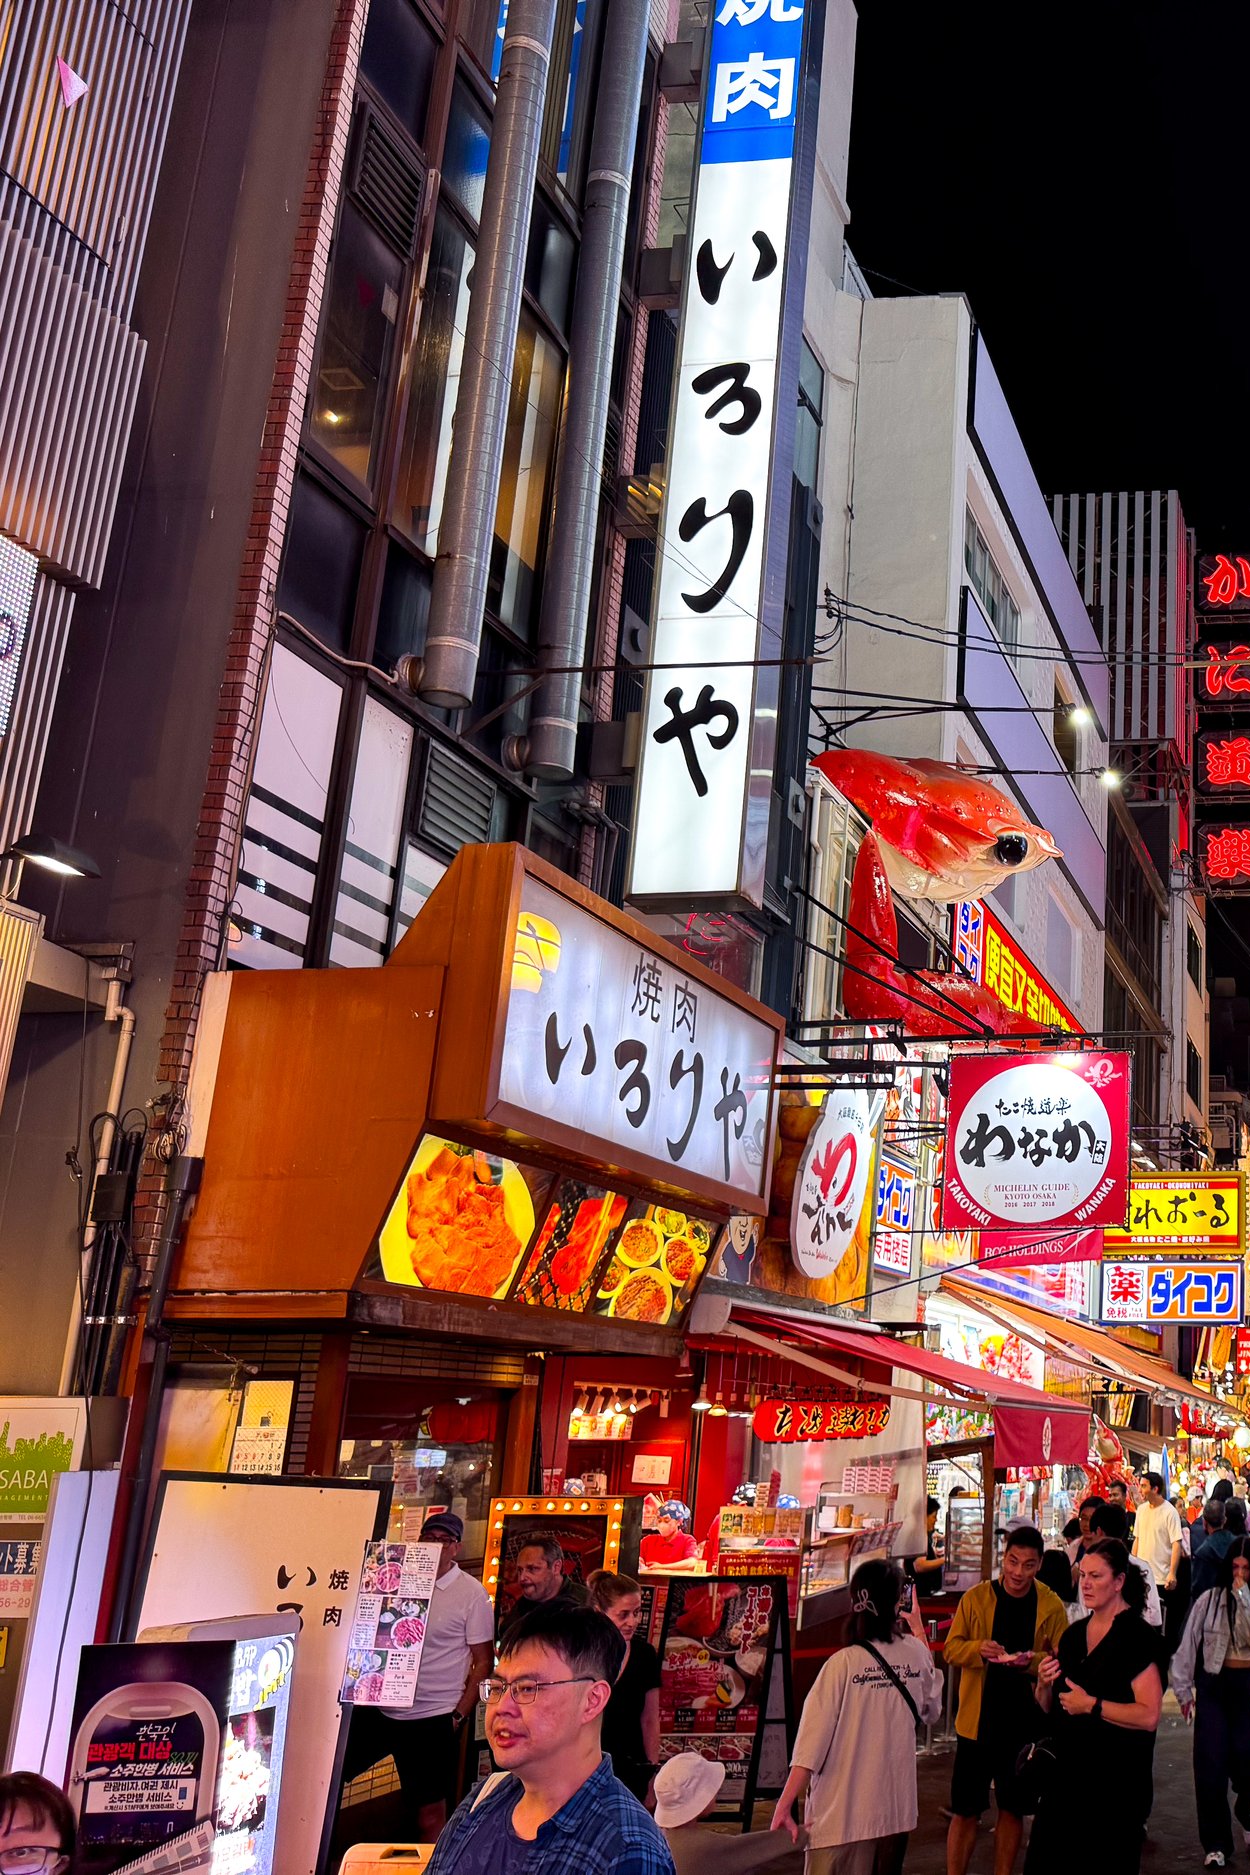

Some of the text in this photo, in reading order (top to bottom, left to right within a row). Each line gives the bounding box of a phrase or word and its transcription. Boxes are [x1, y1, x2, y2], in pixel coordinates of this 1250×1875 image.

[652, 231, 777, 798] いろりや
[631, 952, 698, 1043] 焼肉
[545, 1011, 750, 1181] いろりや
[960, 1113, 1096, 1168] わなか
[945, 1177, 992, 1226] TAKOYAKI
[993, 1183, 1070, 1192] MICHELIN GUIDE
[1074, 1177, 1117, 1223] WANAKA
[1130, 1192, 1230, 1230] れおーる
[1110, 1266, 1142, 1304] 薬
[1150, 1271, 1236, 1315] ダイコク
[1106, 1307, 1128, 1319] 免税
[322, 1569, 350, 1628] 焼肉
[87, 1741, 173, 1762] 관광객 대상
[136, 1722, 177, 1741] 한국인
[157, 1762, 194, 1775] 서비스
[146, 1792, 173, 1802] 서비스
